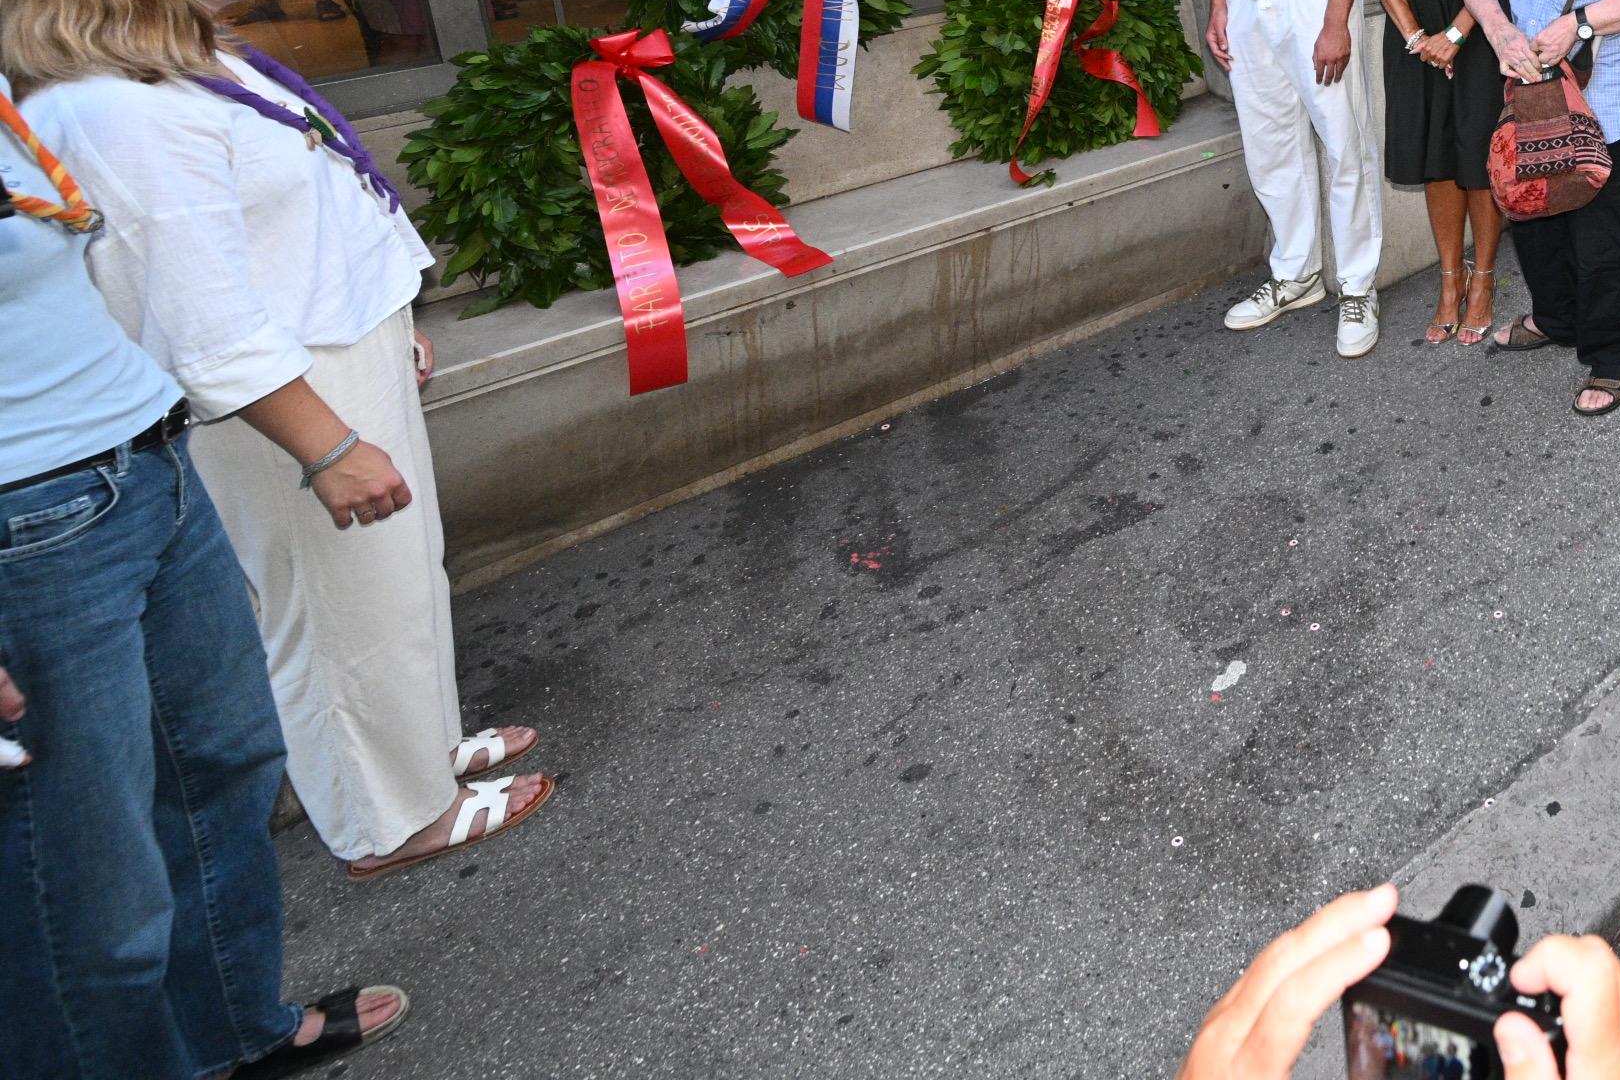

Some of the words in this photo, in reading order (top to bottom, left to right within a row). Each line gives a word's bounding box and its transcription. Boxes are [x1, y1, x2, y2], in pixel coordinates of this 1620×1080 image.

[815, 39, 850, 91] DOM
[578, 78, 641, 215] DEMOCRATICO
[616, 232, 671, 335] PARTITO
